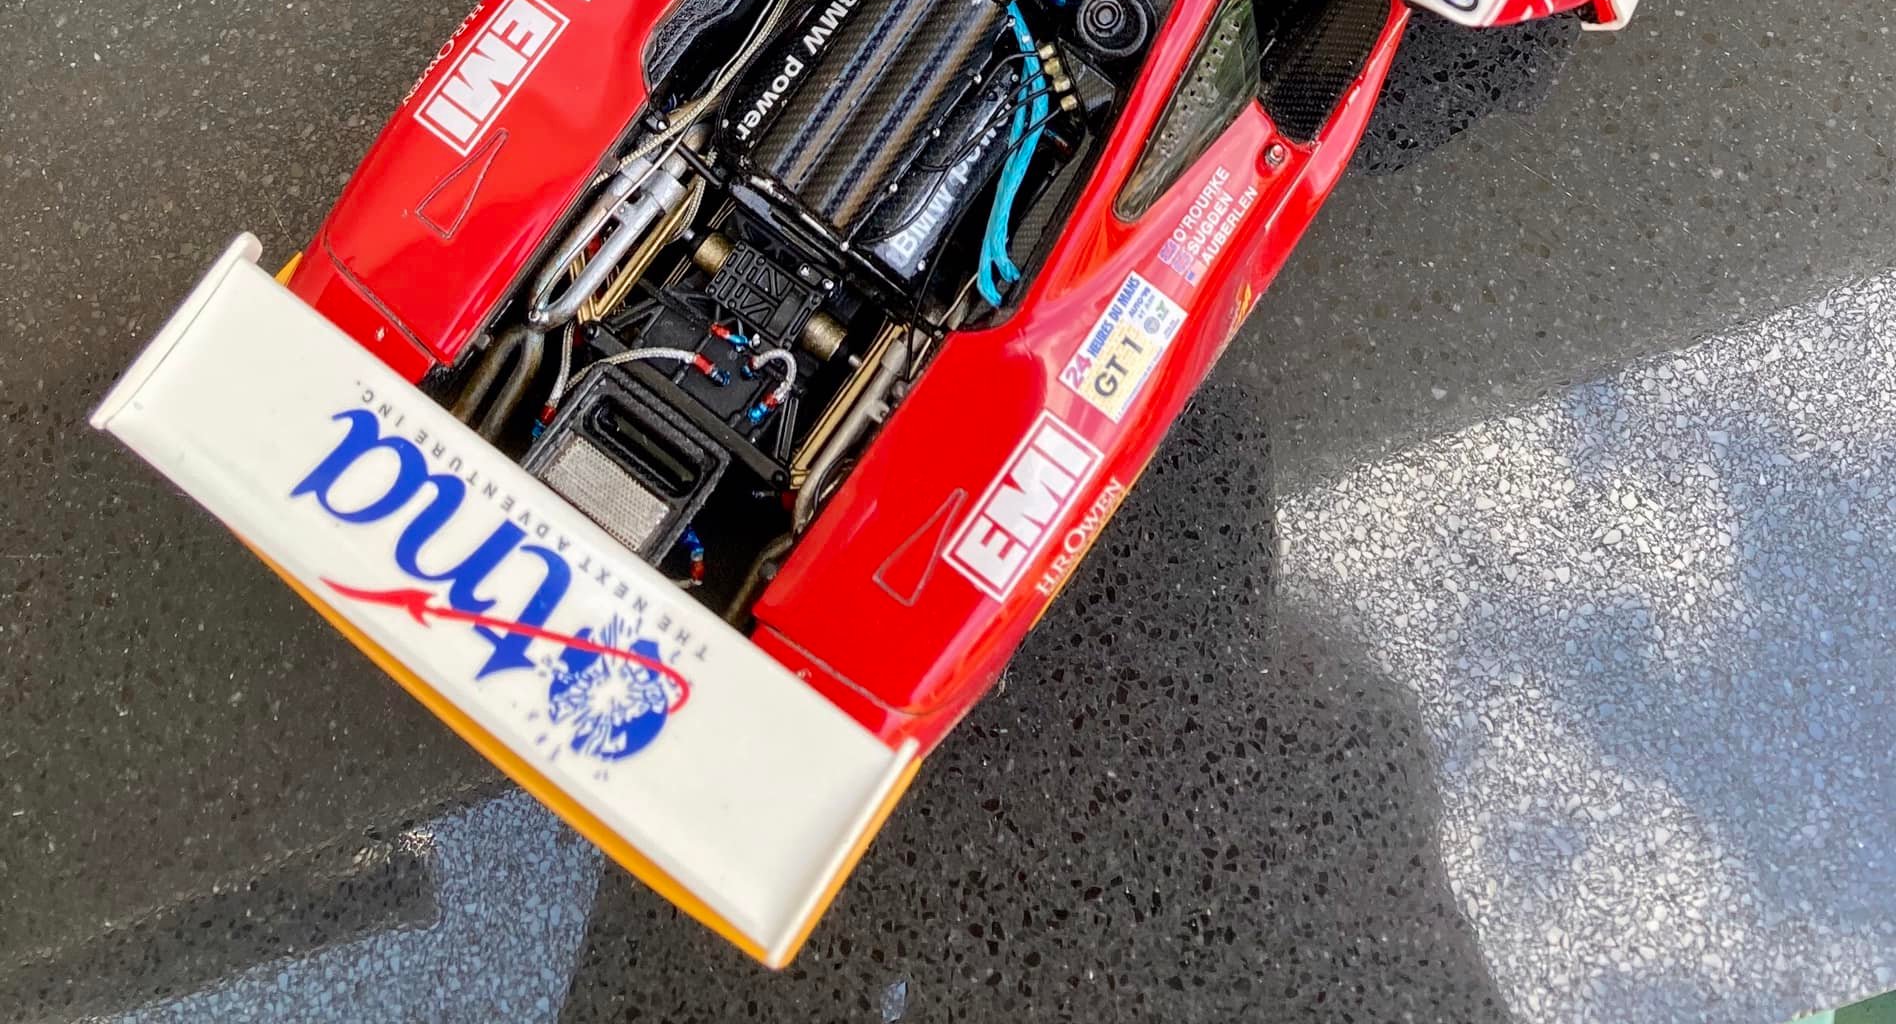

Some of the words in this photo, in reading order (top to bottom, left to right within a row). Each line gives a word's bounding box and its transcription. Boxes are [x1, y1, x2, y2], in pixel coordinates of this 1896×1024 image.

[736, 54, 804, 141] power
[891, 184, 956, 259] BMW
[1173, 166, 1231, 242] O'ROURKE
[1187, 192, 1234, 256] SUGDEN
[1201, 185, 1258, 267] AUBERLEN
[1065, 353, 1093, 390] 24
[1086, 319, 1114, 359] HEURES
[1107, 304, 1124, 323] DU
[1117, 276, 1141, 308] MANS
[1094, 353, 1129, 397] GT
[1121, 336, 1144, 355] 1
[355, 380, 405, 429] INC.
[414, 428, 572, 553] ADVENTURE
[954, 424, 1093, 590] EMI
[289, 408, 572, 680] tna
[578, 555, 648, 615] NEXT
[658, 615, 709, 663] THE
